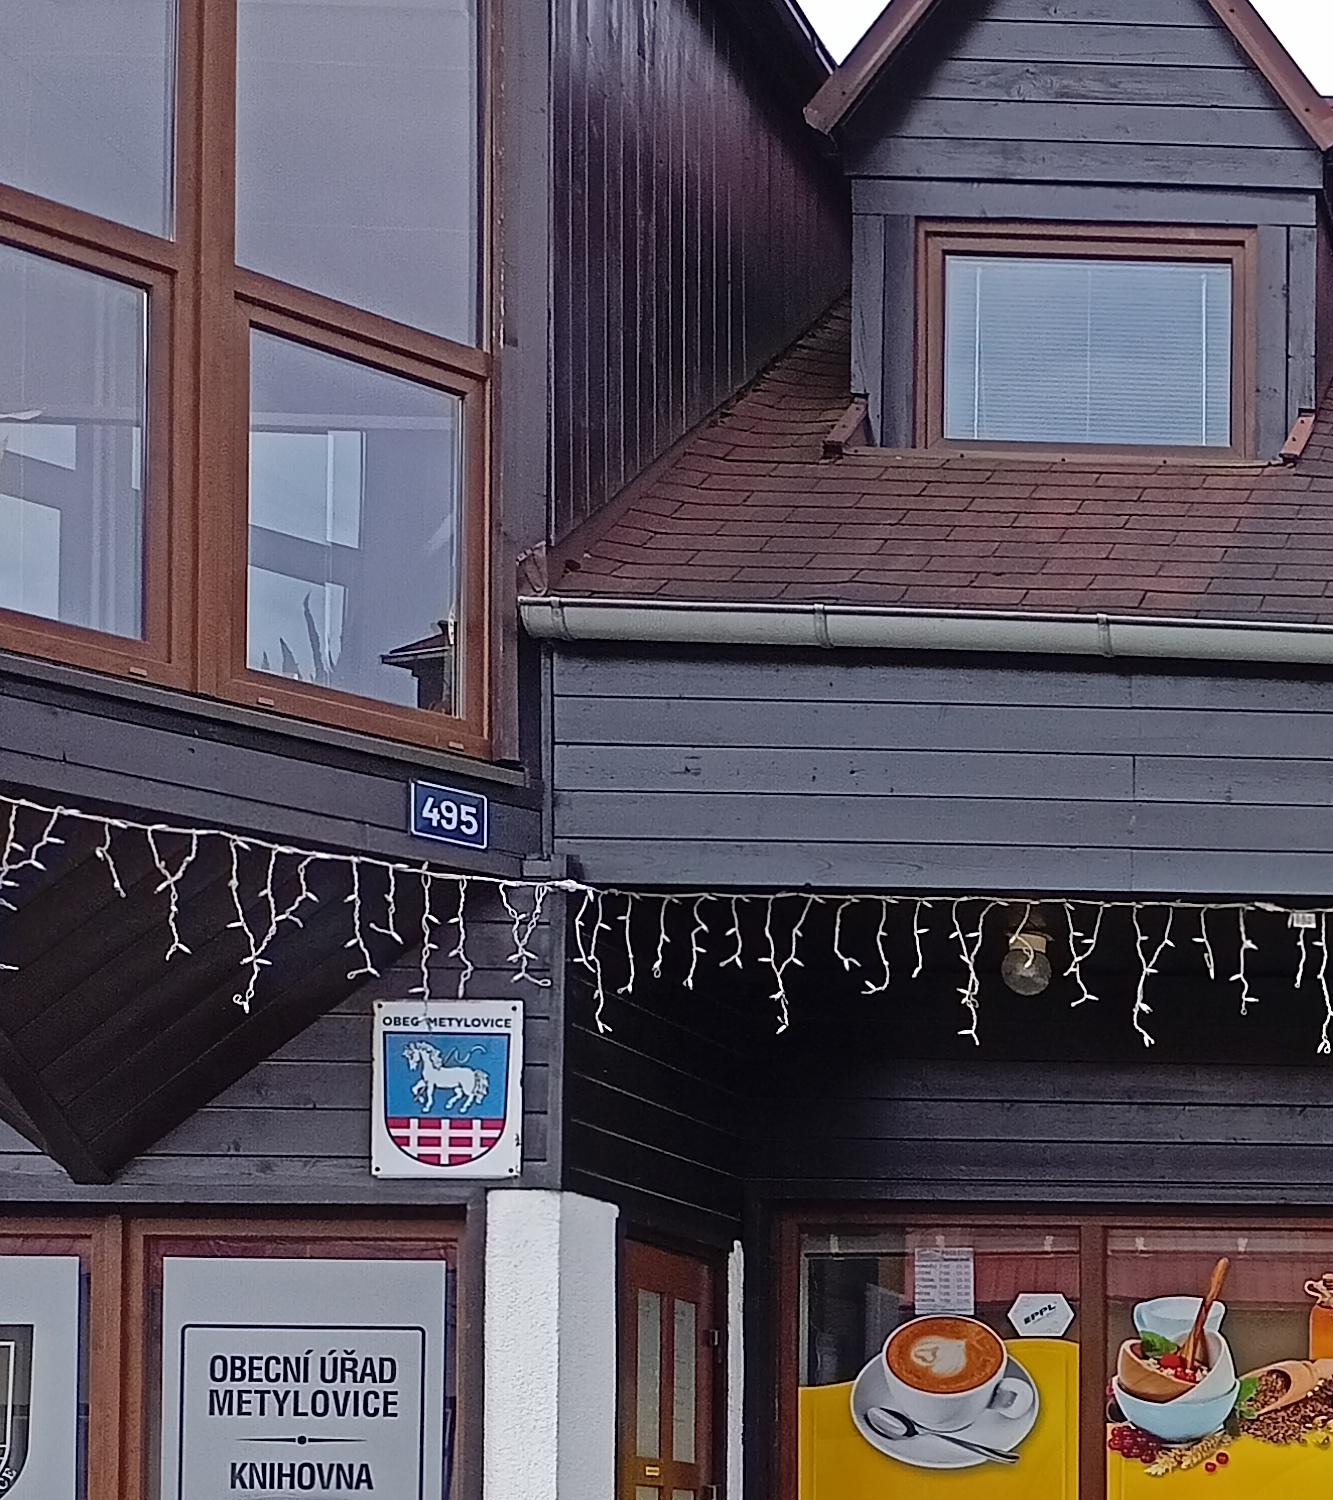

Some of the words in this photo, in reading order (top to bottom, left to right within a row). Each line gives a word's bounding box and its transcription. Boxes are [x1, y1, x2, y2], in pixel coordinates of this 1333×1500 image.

[422, 797, 478, 835] 495
[428, 1017, 512, 1028] METYLOVICE
[210, 1349, 314, 1383] OBECNÍ
[320, 1349, 397, 1384] ÚŘAD
[208, 1389, 399, 1417] METYLOVICE
[230, 1462, 374, 1490] KNIHOVNA
